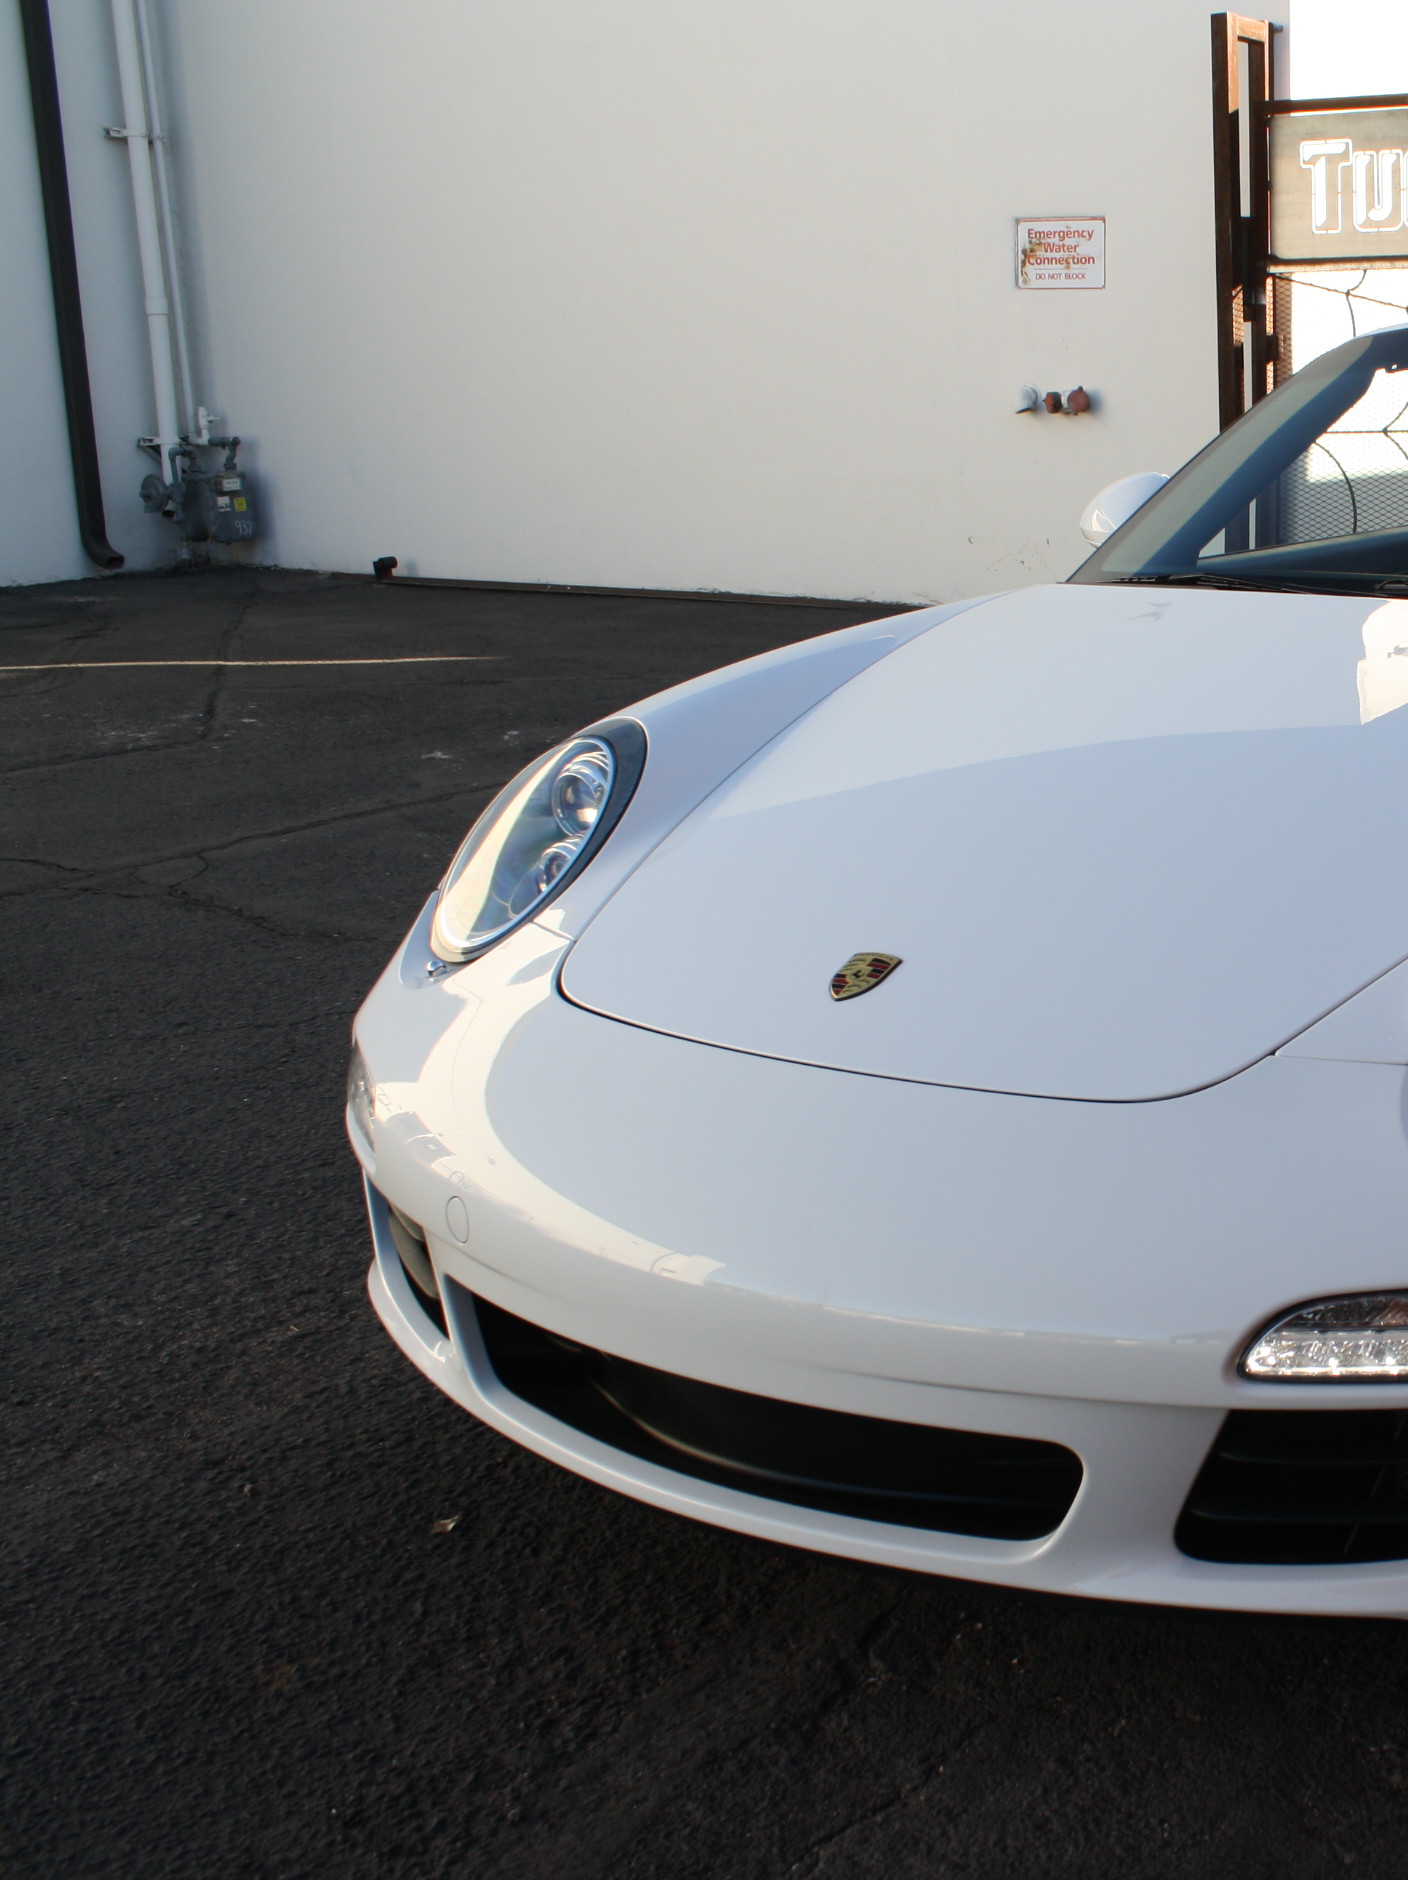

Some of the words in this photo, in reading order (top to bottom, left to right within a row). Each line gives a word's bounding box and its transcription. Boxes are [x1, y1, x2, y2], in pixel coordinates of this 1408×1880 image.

[1027, 228, 1094, 241] Emergency
[1043, 243, 1079, 253] Water
[1027, 254, 1095, 266] Connection
